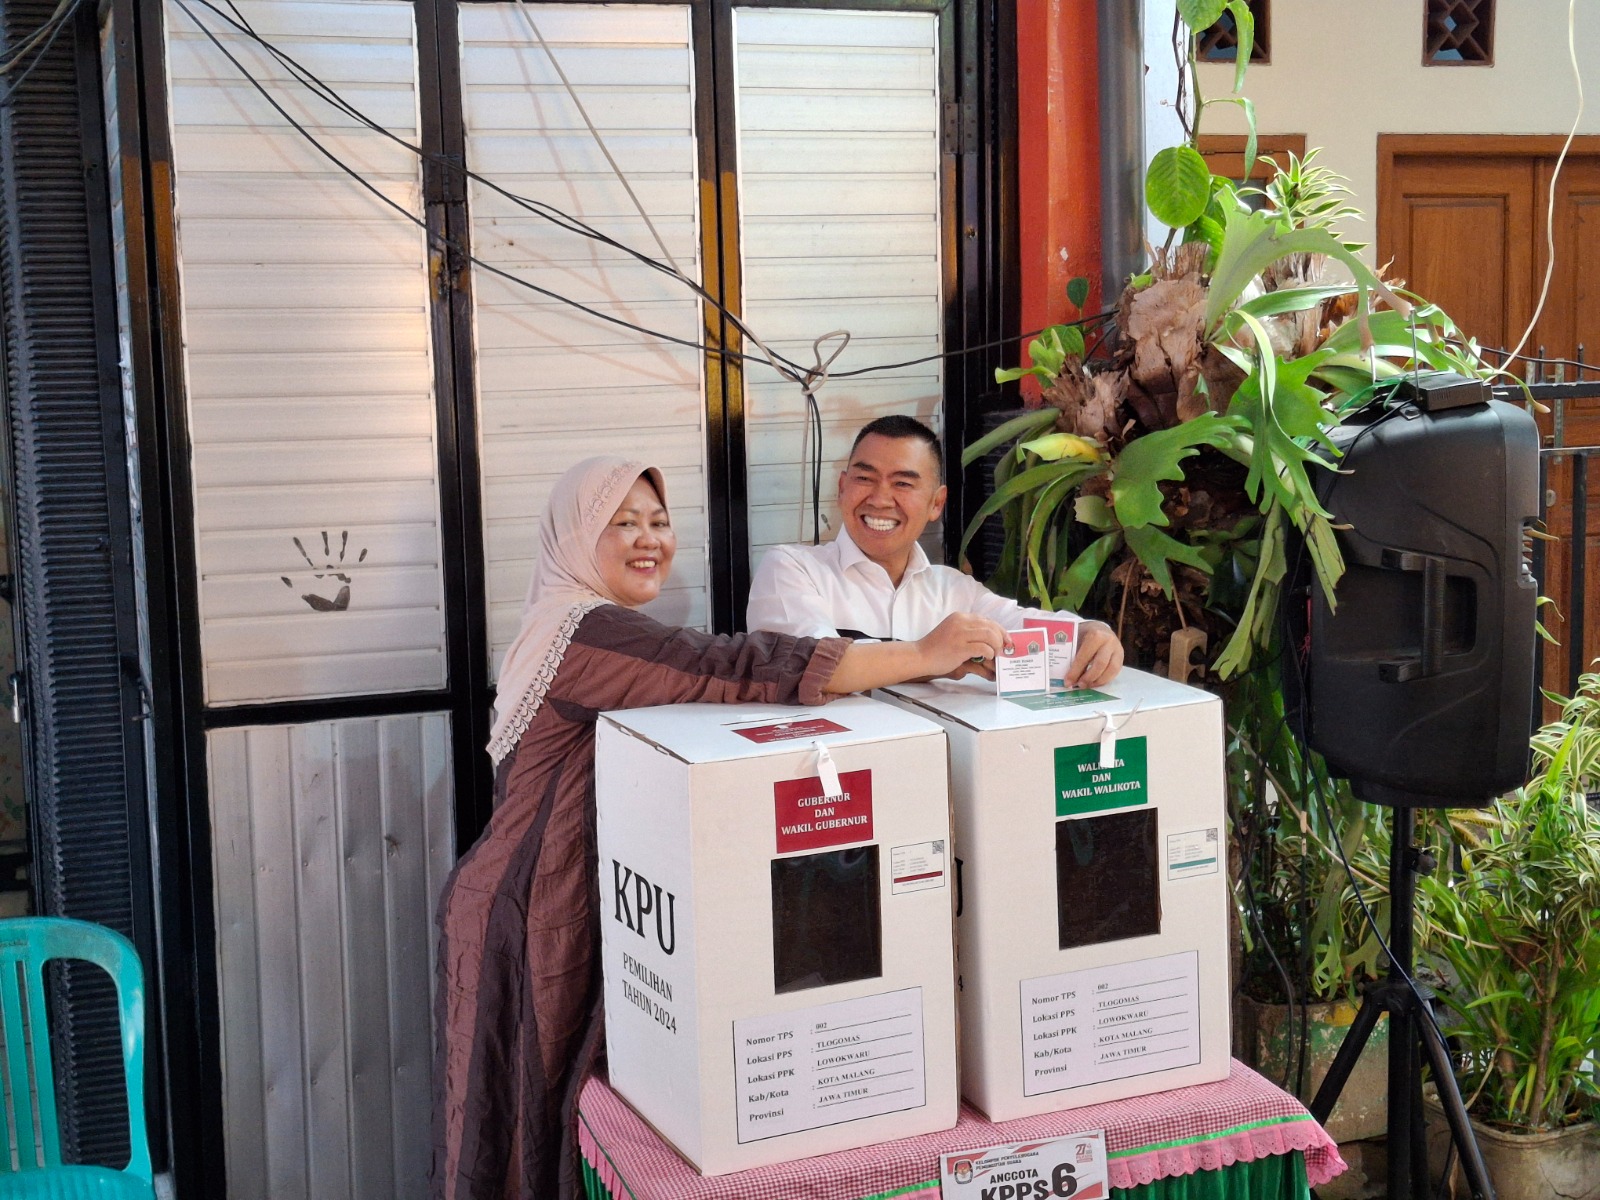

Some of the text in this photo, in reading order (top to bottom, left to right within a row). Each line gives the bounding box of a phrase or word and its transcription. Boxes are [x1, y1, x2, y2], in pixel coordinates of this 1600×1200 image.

[1062, 781, 1140, 799] WAKIL WALIKOTA
[1092, 773, 1111, 783] DAN
[798, 793, 850, 807] GUBERNUR
[815, 807, 834, 817] DAN
[781, 815, 867, 835] WAKIL GUBERNUR
[612, 859, 675, 955] KPU
[623, 952, 672, 1002] PEMILIHAN
[622, 979, 676, 1034] TAHUN 2024
[1032, 995, 1059, 1005] Nomor
[1061, 991, 1076, 1000] TPS
[1033, 996, 1139, 1023] Lokasi PPS TLOGOMAS
[746, 1022, 827, 1046] Nomor TPS 002
[1033, 1010, 1149, 1041] Lokasi PPK LOWOKWARU
[747, 1035, 860, 1065] Lokasi PPS TLOGOMAS
[1034, 1028, 1153, 1058] Kab/Kota KOTA MALANG
[748, 1051, 870, 1084] Lokasi PPK LOWOKWARU
[1035, 1046, 1146, 1076] Provinsi JAWA TIMUR
[749, 1069, 875, 1103] Kab/Kota KOTA MALANG
[749, 1088, 868, 1122] Provinsi JAWA TIMUR
[1075, 1144, 1086, 1155] 27
[981, 1163, 1077, 1200] KPPS 6
[990, 1169, 1038, 1184] ANGGOTA
